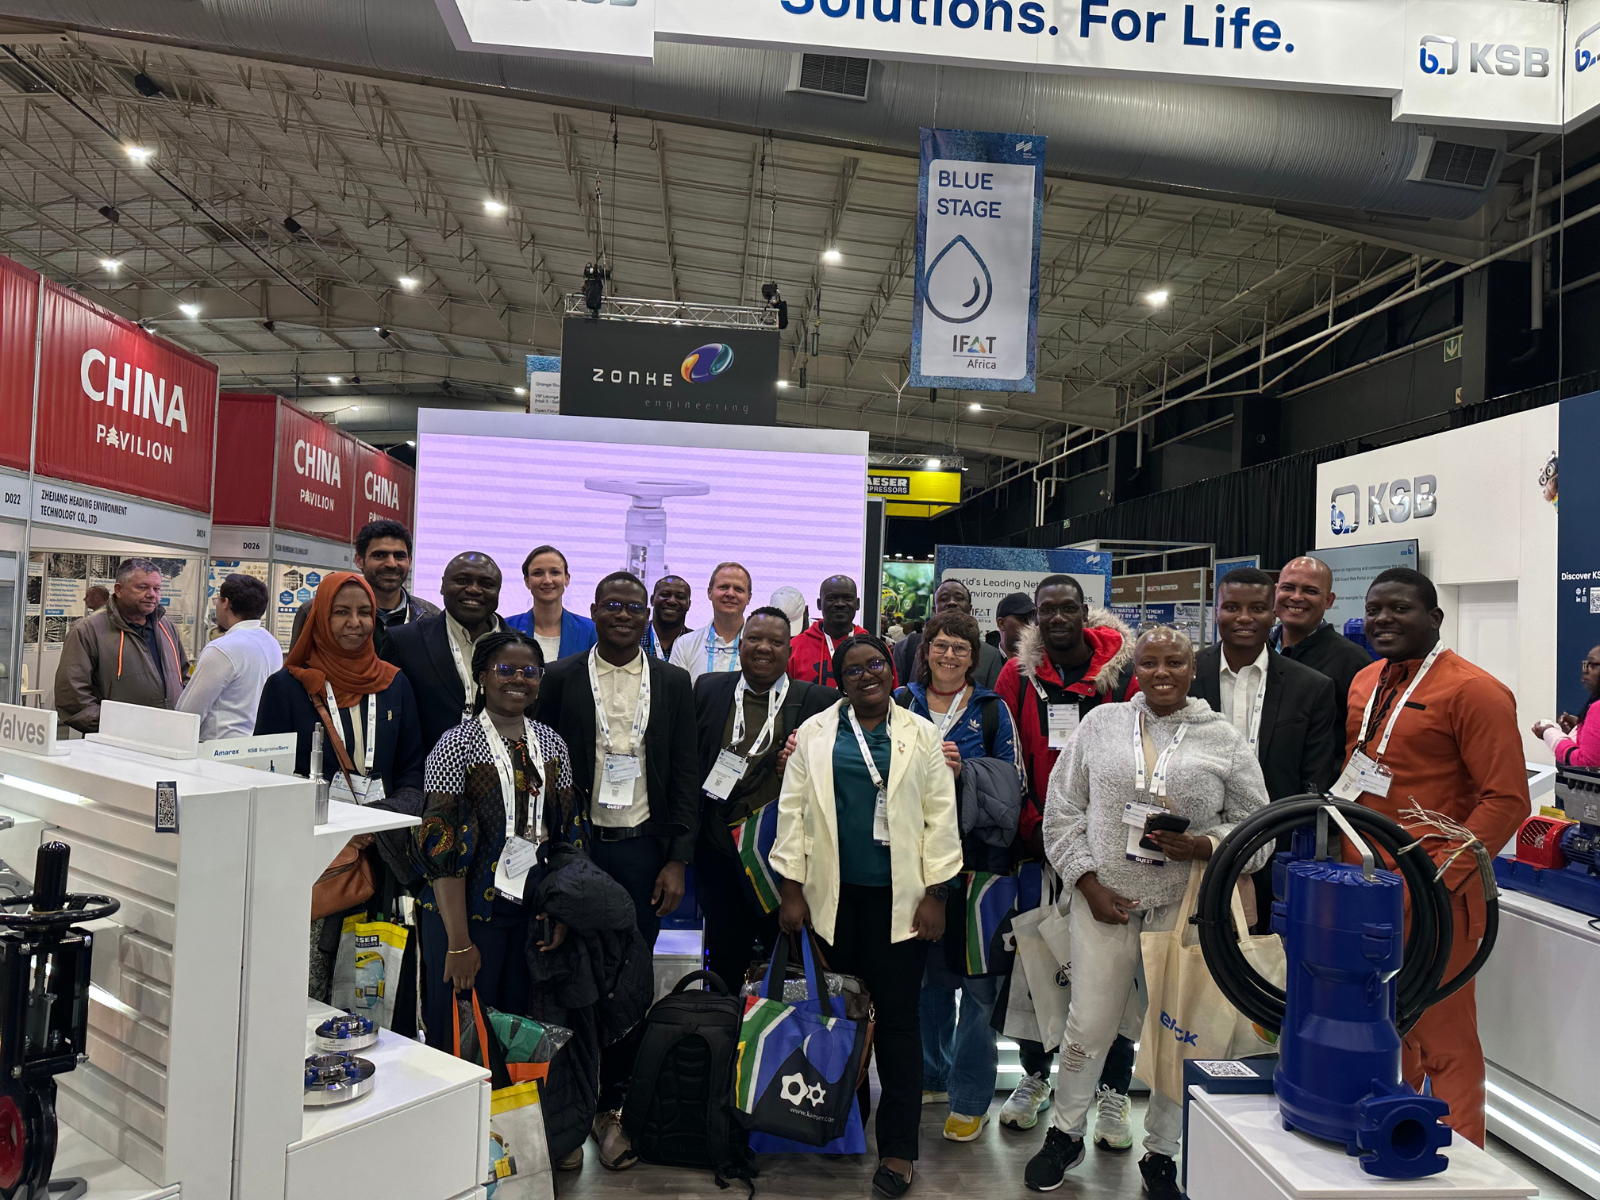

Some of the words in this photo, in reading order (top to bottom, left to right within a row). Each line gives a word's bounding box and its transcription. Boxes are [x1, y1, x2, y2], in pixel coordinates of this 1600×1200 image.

[1080, 0, 1166, 43] For
[1183, 4, 1294, 53] Life.
[1470, 42, 1549, 78] KSB
[938, 170, 993, 190] BLUE
[936, 198, 1002, 218] STAGE
[952, 335, 997, 354] IFAT
[967, 358, 997, 370] Africa
[81, 348, 188, 433] CHINA
[645, 400, 749, 414] engineering
[294, 439, 341, 488] CHINA
[867, 476, 908, 487] AESER
[868, 485, 907, 494] PRESSORS
[5, 492, 21, 505] D022
[364, 471, 400, 511] CHINA
[41, 489, 68, 504] ZHEJIANG
[93, 500, 128, 516] ENVIRONMENT
[1368, 474, 1437, 526] KSB
[41, 505, 76, 521] TECHNOLOGY
[88, 514, 98, 525] LTD
[243, 542, 260, 550] D026
[984, 578, 1021, 589] Leading
[1561, 571, 1591, 580] Discover
[969, 590, 1012, 599] nvironm
[213, 749, 240, 757] Amarex
[1135, 856, 1153, 865] GUEST
